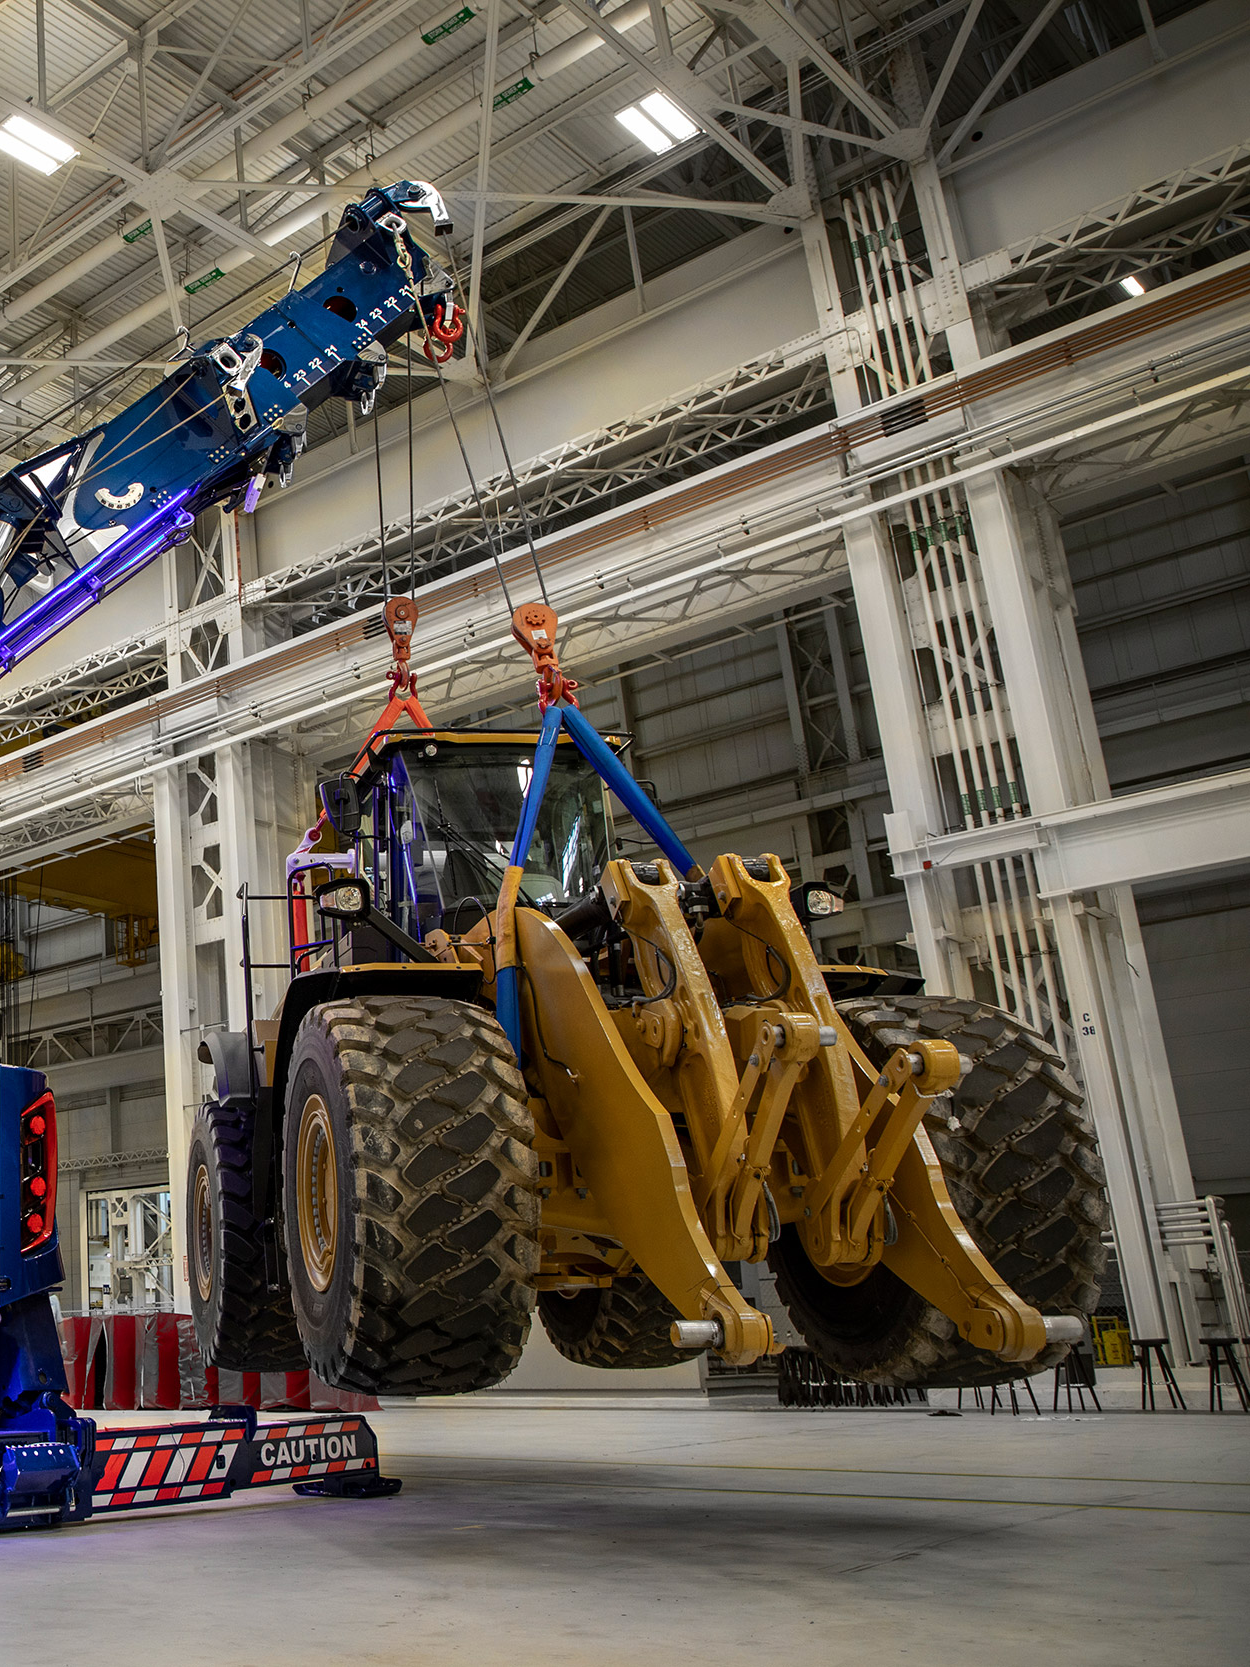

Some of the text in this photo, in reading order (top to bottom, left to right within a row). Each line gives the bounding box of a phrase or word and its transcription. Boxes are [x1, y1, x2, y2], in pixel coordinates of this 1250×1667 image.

[399, 284, 413, 297] 21
[384, 296, 398, 308] 22
[369, 307, 383, 319] 23
[324, 344, 338, 356] 21
[308, 357, 322, 369] 22
[293, 369, 307, 381] 23
[1082, 1012, 1091, 1022] C
[260, 1434, 357, 1467] CAUTION
